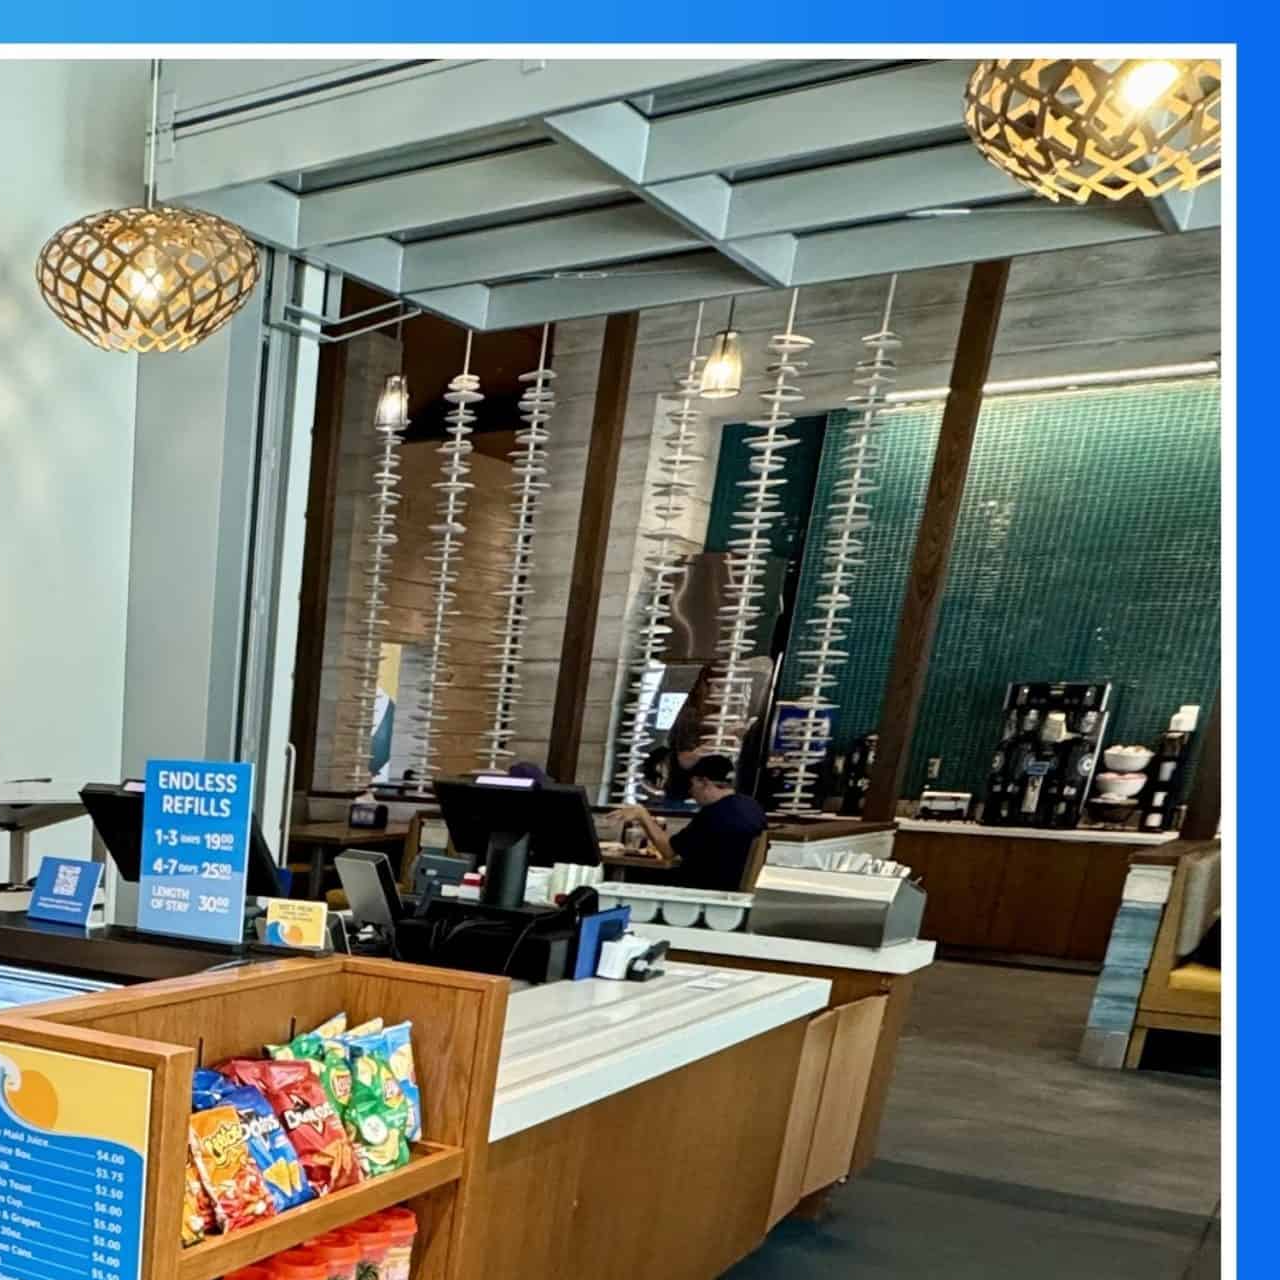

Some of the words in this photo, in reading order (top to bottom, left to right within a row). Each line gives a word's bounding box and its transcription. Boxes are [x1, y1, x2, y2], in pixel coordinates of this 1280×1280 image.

[158, 770, 238, 794] ENDLESS
[162, 794, 232, 819] REFILLS
[154, 828, 179, 847] 1-3
[152, 857, 179, 876] 4-7
[151, 885, 190, 900] LENGTH
[151, 898, 164, 909] OF
[165, 899, 190, 912] STAY
[96, 1149, 125, 1166] $4.00
